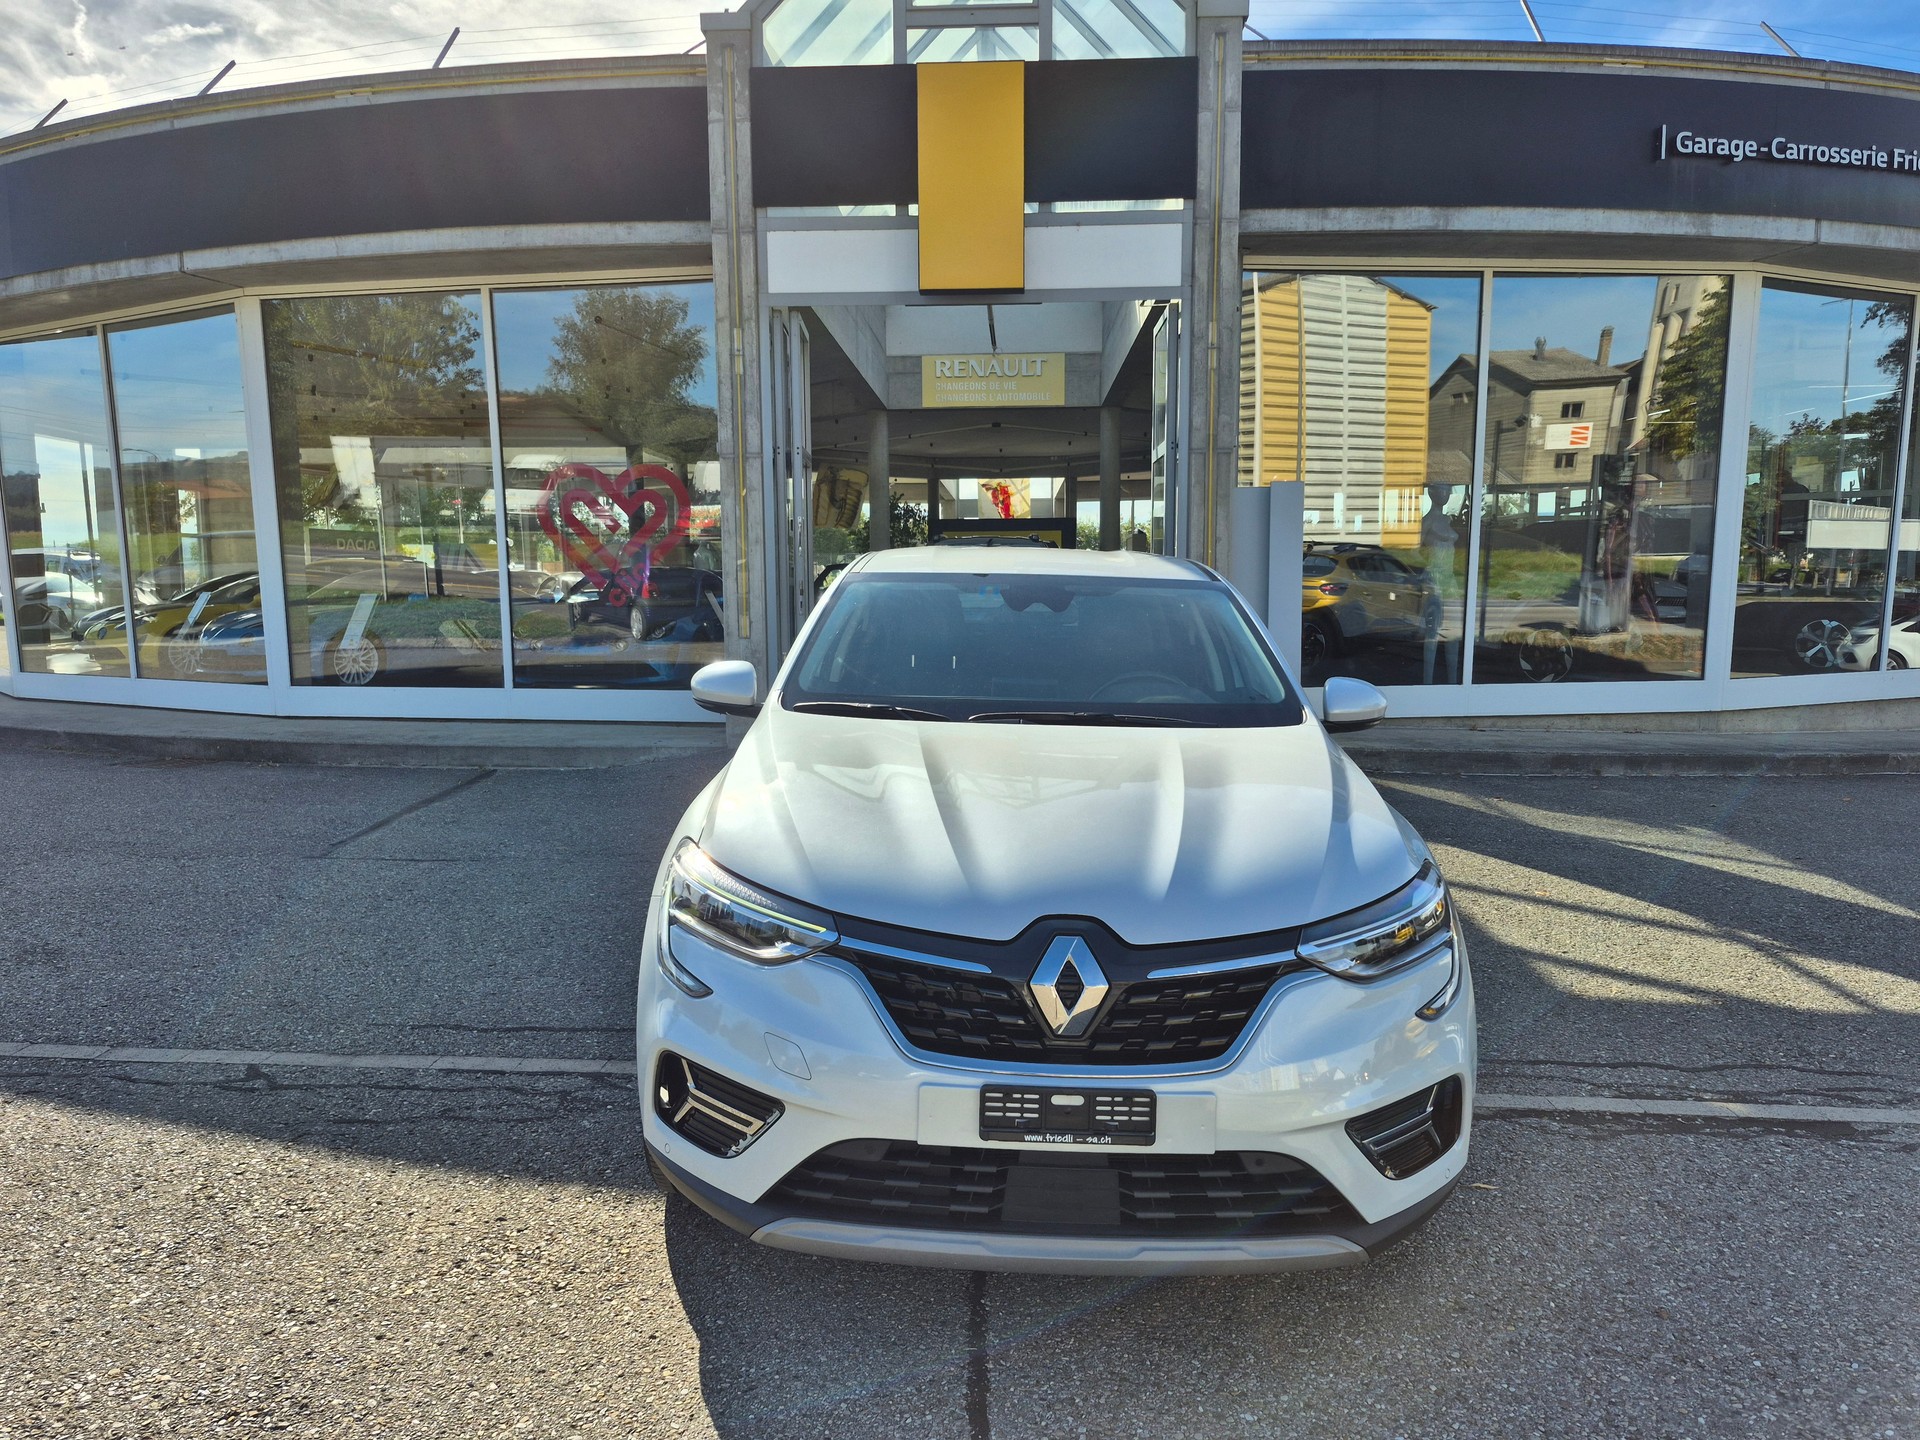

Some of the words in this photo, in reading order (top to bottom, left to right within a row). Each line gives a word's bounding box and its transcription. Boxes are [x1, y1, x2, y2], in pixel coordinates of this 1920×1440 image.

[1893, 148, 1920, 171] Fri
[935, 358, 1048, 379] RENAULT
[935, 381, 987, 391] CHANGEONS
[989, 381, 1001, 391] DE
[1003, 381, 1017, 391] VIE
[935, 393, 987, 402] CHANGEONS
[989, 392, 1052, 402] L'AUTOMOBILE
[336, 538, 376, 551] DACIA
